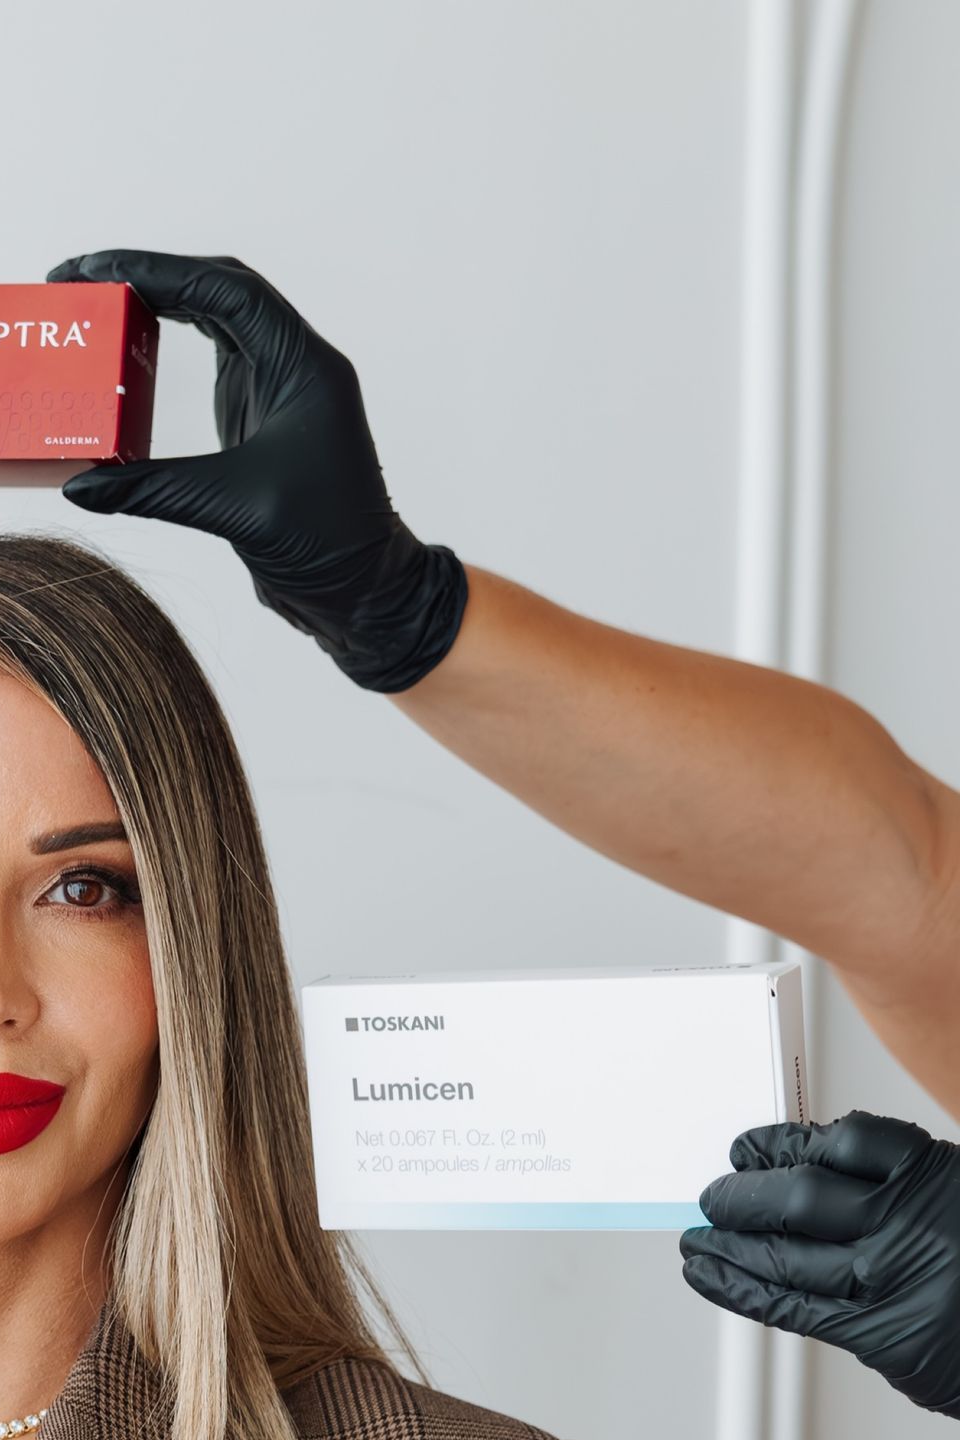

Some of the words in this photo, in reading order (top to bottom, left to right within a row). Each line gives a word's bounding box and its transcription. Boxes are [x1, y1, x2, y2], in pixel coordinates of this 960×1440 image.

[44, 436, 100, 446] GALDERMA
[361, 1015, 445, 1032] TOSKANI
[352, 1076, 474, 1101] Lumicen
[795, 1055, 804, 1125] umicen
[355, 1129, 385, 1147] Net
[389, 1129, 436, 1147] 0.067
[442, 1129, 461, 1147] Fl.
[466, 1128, 495, 1147] Oz.
[501, 1128, 517, 1149] (2
[521, 1128, 546, 1148] ml)
[357, 1158, 367, 1173] x
[371, 1155, 393, 1173] 20
[398, 1155, 480, 1175] ampoules
[483, 1157, 491, 1173] /
[495, 1155, 571, 1175] ampollas
